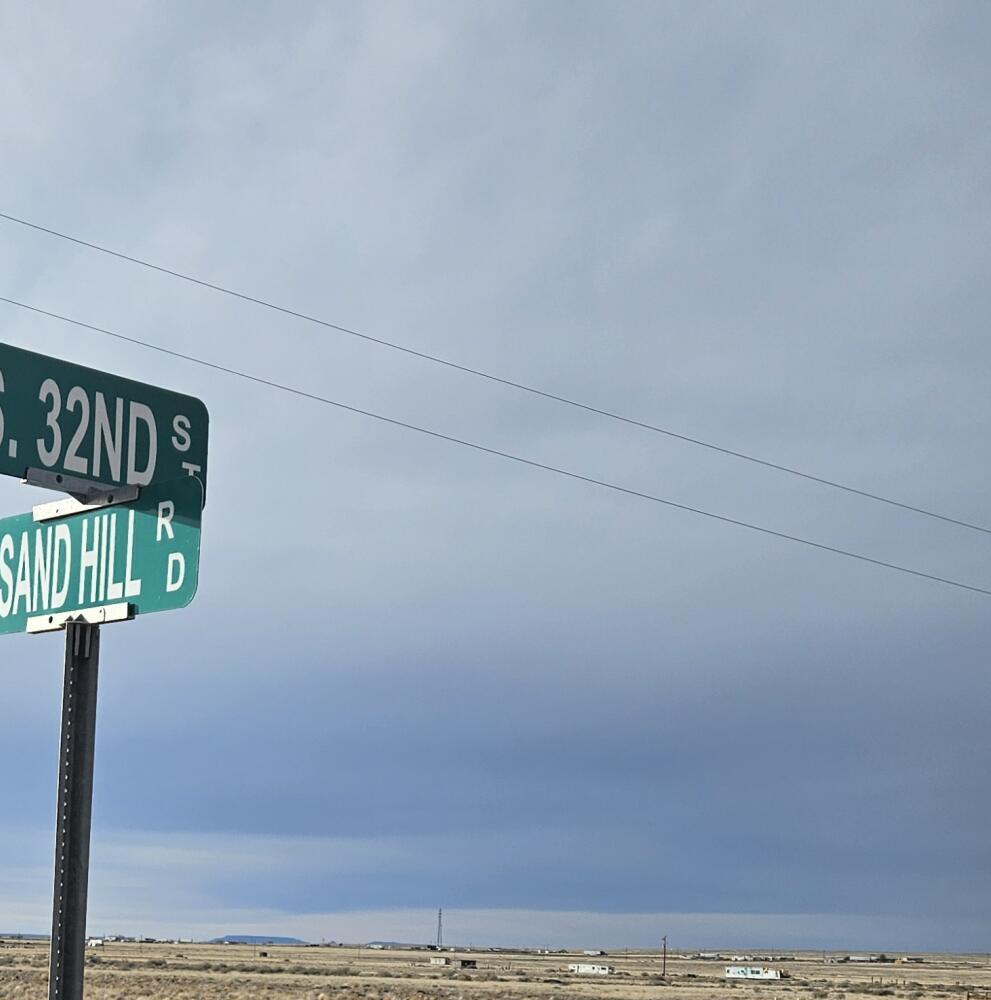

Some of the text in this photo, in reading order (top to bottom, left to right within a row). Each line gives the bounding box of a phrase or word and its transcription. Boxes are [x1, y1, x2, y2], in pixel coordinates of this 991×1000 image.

[36, 378, 158, 487] 32ND
[78, 509, 142, 605] HILL
[156, 500, 186, 593] RD
